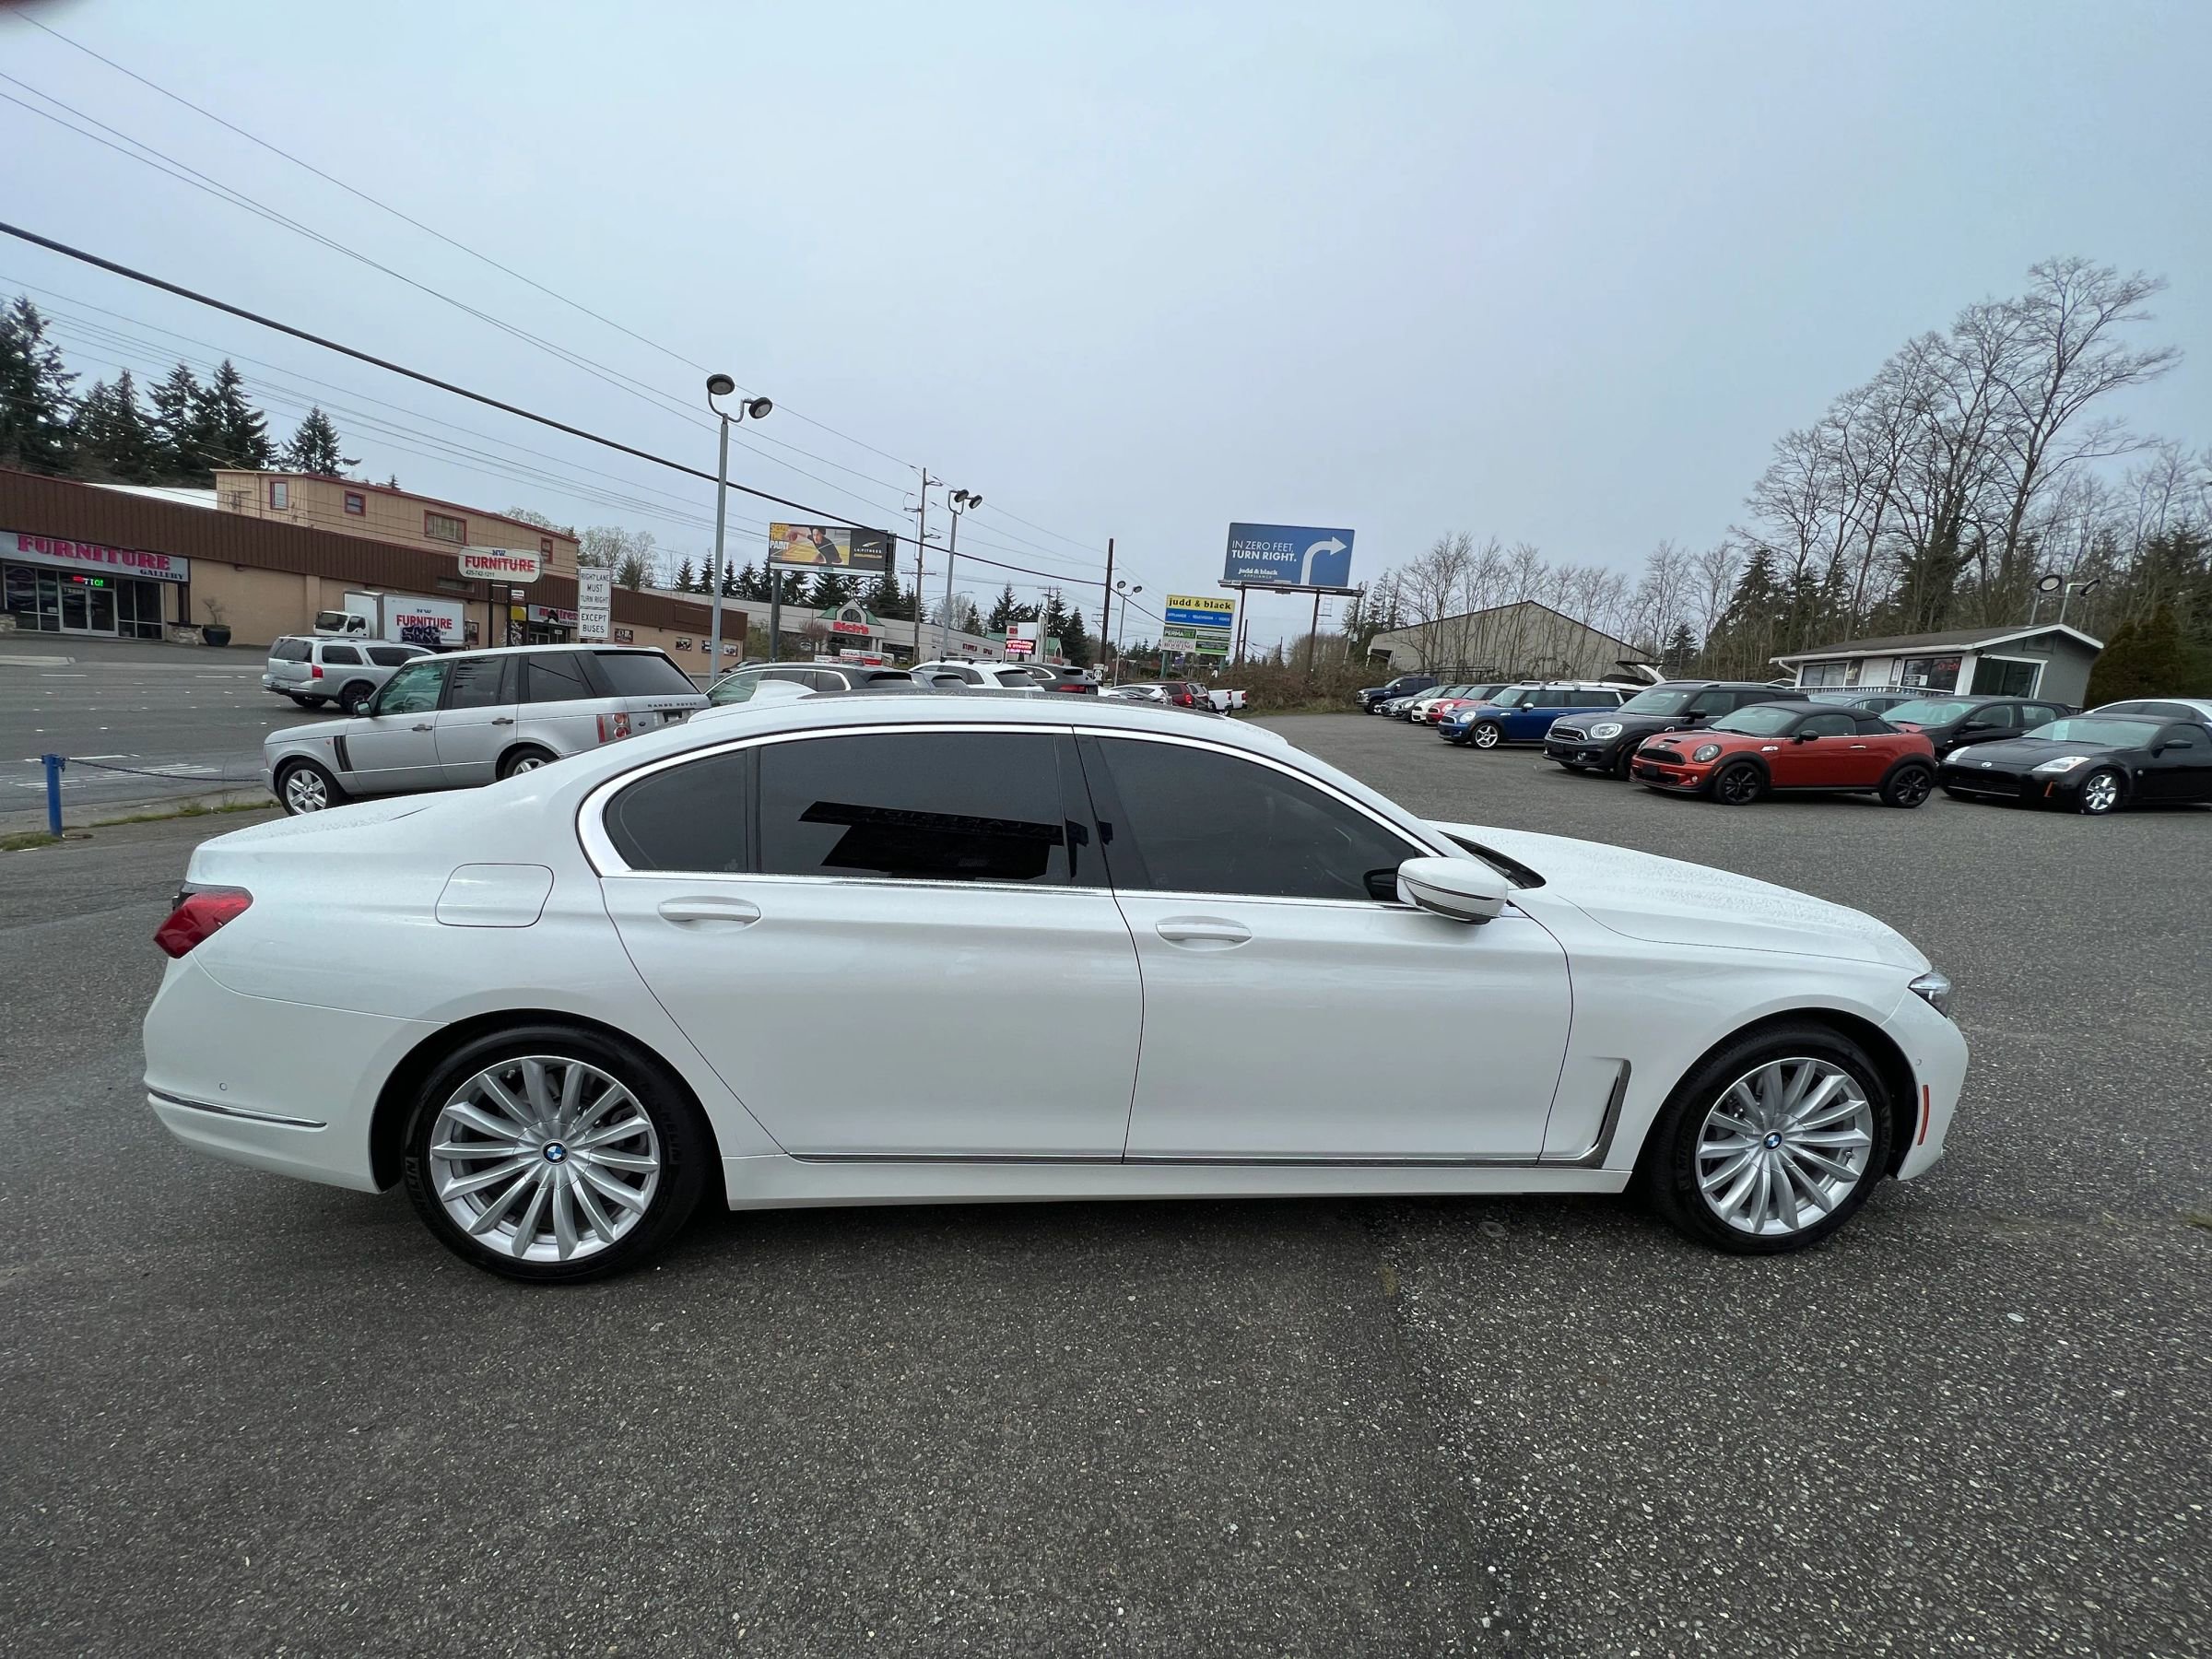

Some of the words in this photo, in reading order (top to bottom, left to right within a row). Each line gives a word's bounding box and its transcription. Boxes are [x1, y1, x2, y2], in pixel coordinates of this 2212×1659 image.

[770, 540, 789, 550] PAINT
[1231, 540, 1242, 549] IN
[1245, 540, 1270, 551] ZERO
[1273, 542, 1294, 553] FEET,
[17, 534, 171, 571] FURNITURE
[1231, 549, 1261, 560] TURN
[1262, 552, 1297, 562] RIGHT.
[465, 555, 535, 573] FURNITURE
[139, 569, 184, 580] GALLERY
[582, 572, 595, 581] RIGHT
[596, 573, 609, 582] LANE
[1238, 567, 1253, 575] judd
[586, 583, 603, 593] MUST
[594, 595, 608, 604] RIGHT
[1169, 597, 1192, 606] judd
[1194, 599, 1200, 607] &
[1204, 600, 1231, 609] black
[539, 607, 578, 620] mtres
[582, 613, 606, 622] EXCEPT
[396, 615, 453, 629] FURNITURE
[832, 621, 869, 634] Rich's
